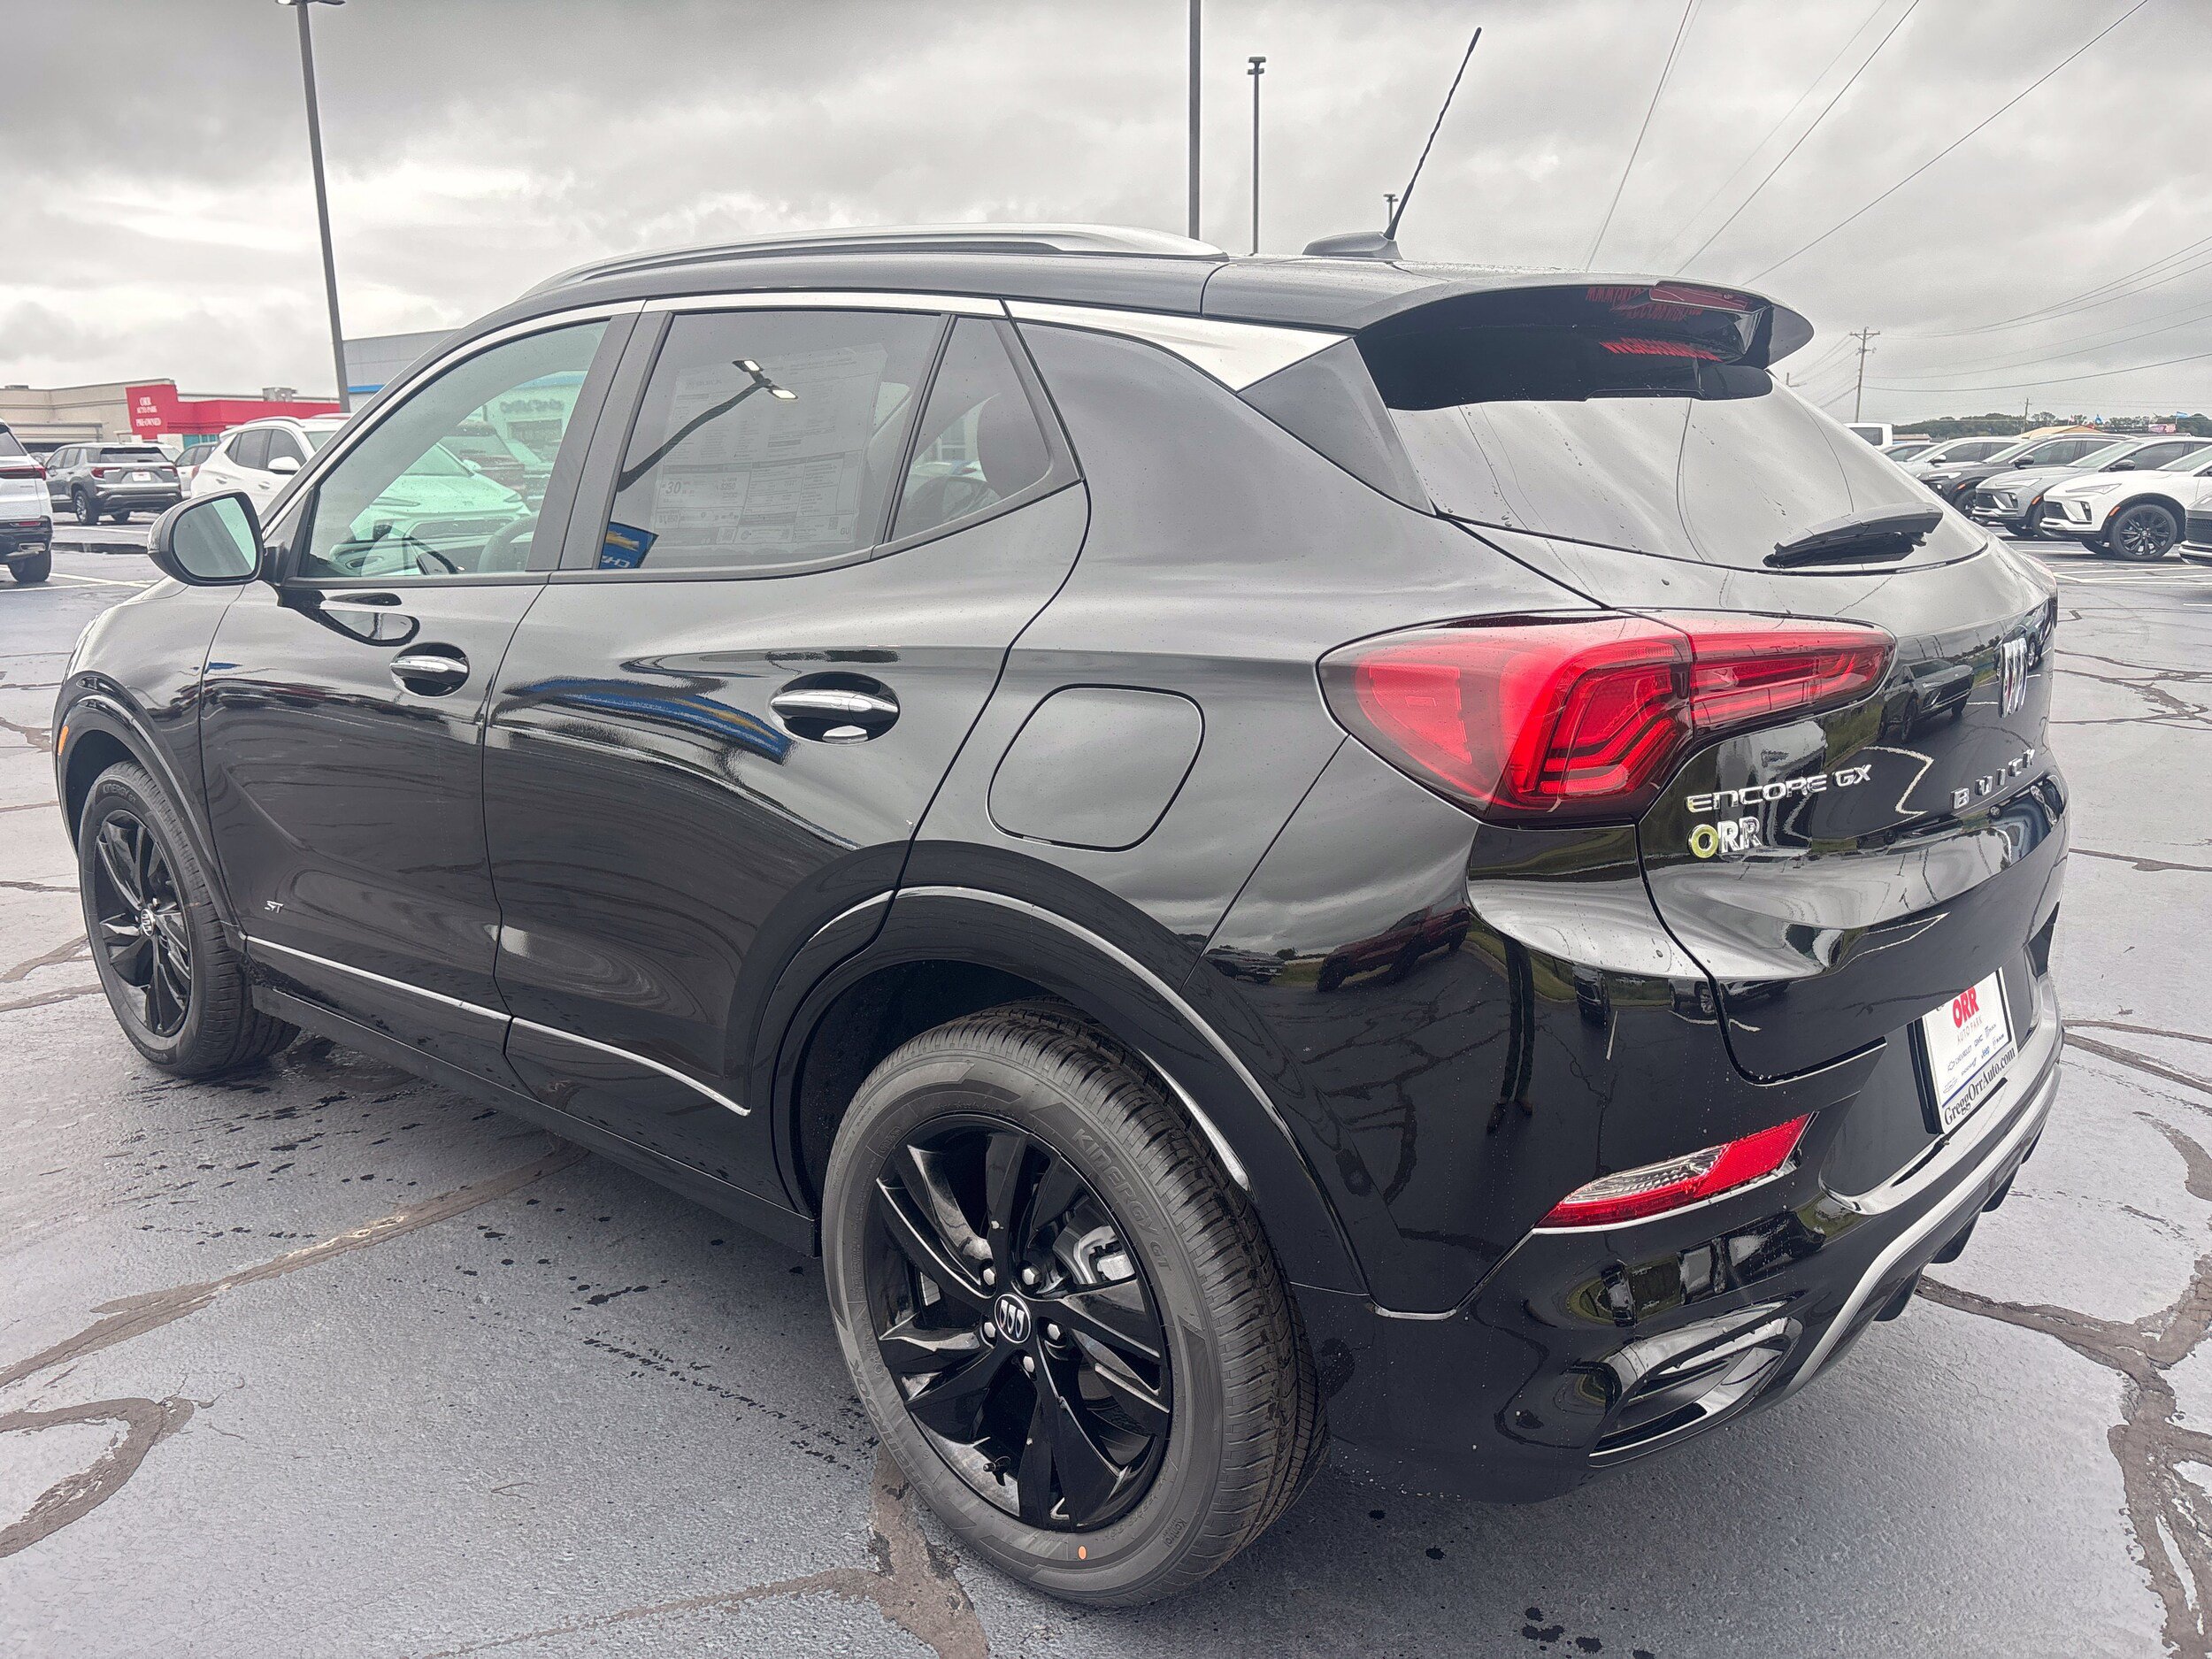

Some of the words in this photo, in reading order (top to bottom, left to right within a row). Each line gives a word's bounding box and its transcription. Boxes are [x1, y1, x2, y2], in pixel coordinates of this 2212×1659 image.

[1686, 773, 1828, 813] ENCORE
[1832, 764, 1872, 787] GX
[1950, 749, 2035, 809] BUICK
[1688, 816, 1763, 858] ORR
[265, 899, 284, 914] ST
[1952, 986, 1979, 1028] ORR
[1944, 1047, 2016, 1125] GreggOrrAuto.com
[1071, 1128, 1160, 1236] KINERGY
[1150, 1240, 1172, 1271] GT
